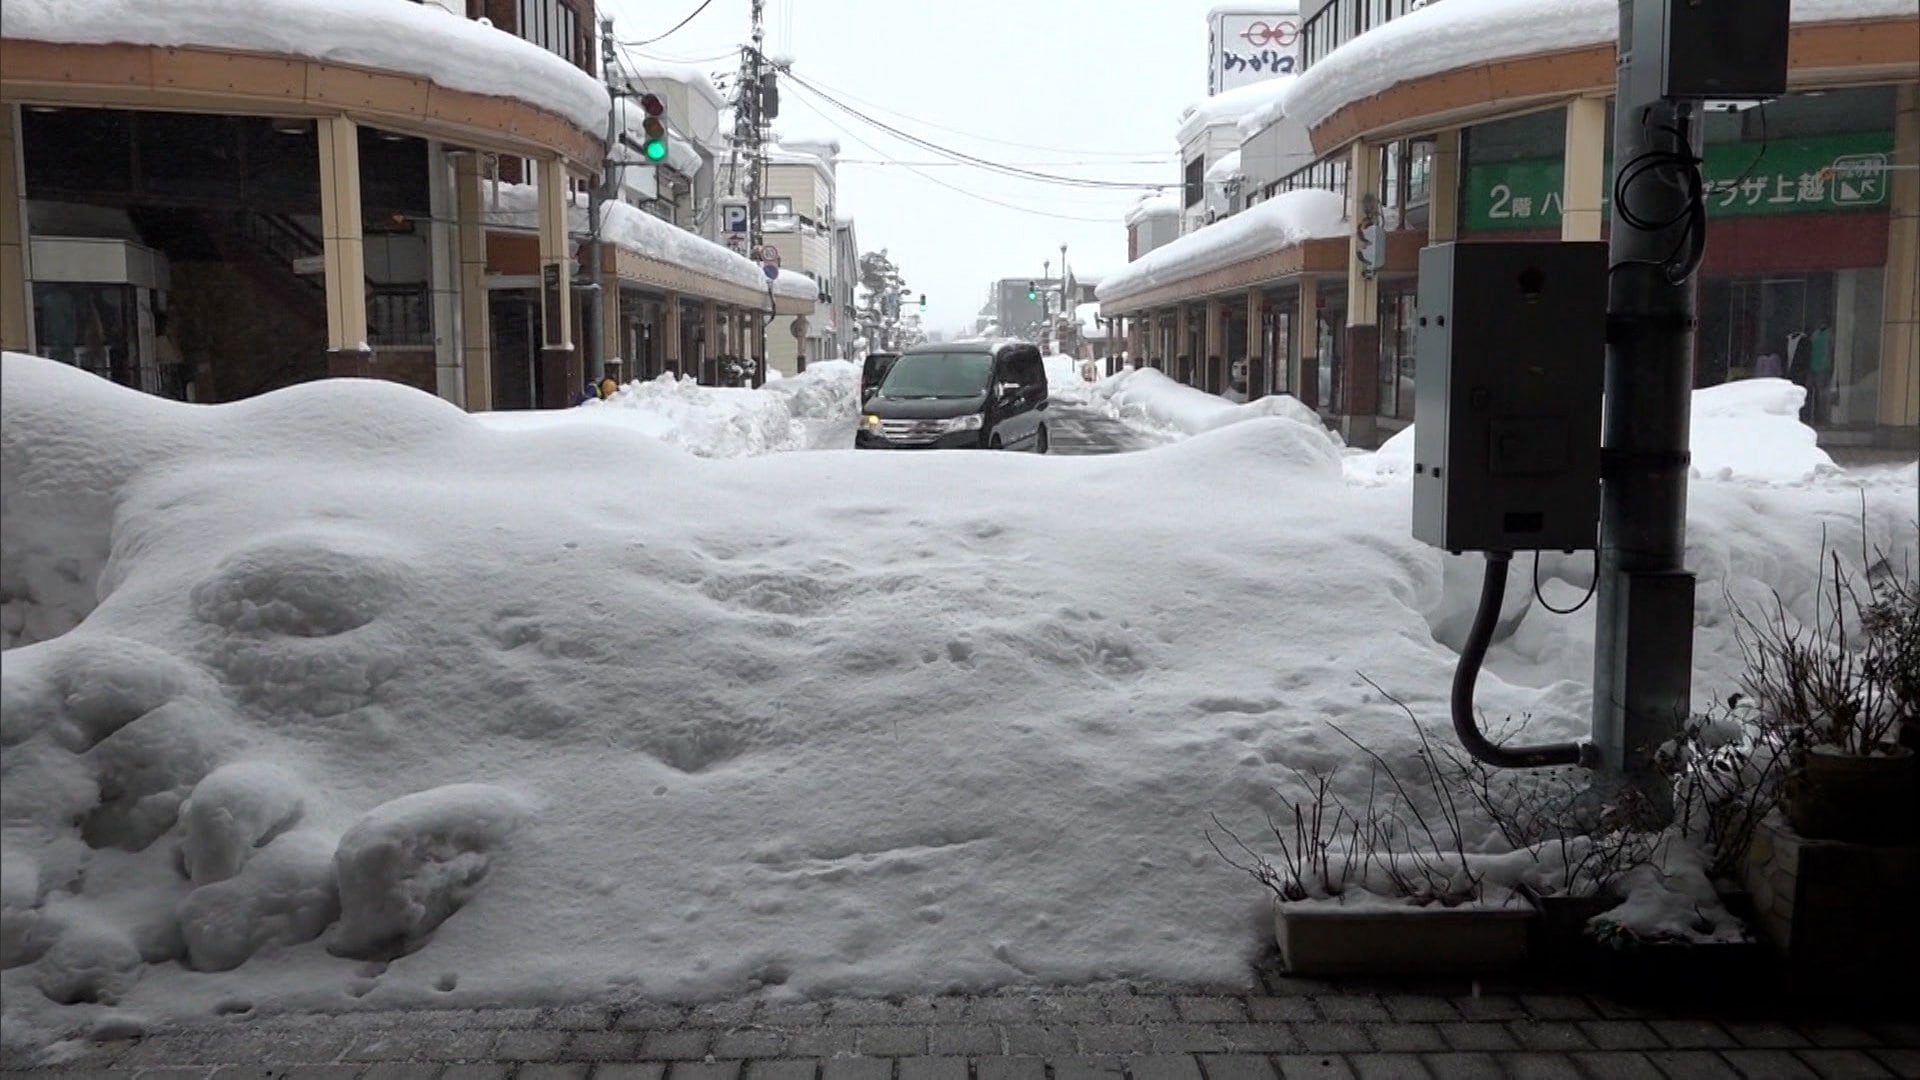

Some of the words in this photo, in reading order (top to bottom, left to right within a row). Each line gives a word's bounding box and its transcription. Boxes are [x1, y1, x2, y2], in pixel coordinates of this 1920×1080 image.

[1223, 49, 1296, 74] めがね
[1489, 185, 1532, 218] 2階
[724, 206, 746, 231] P
